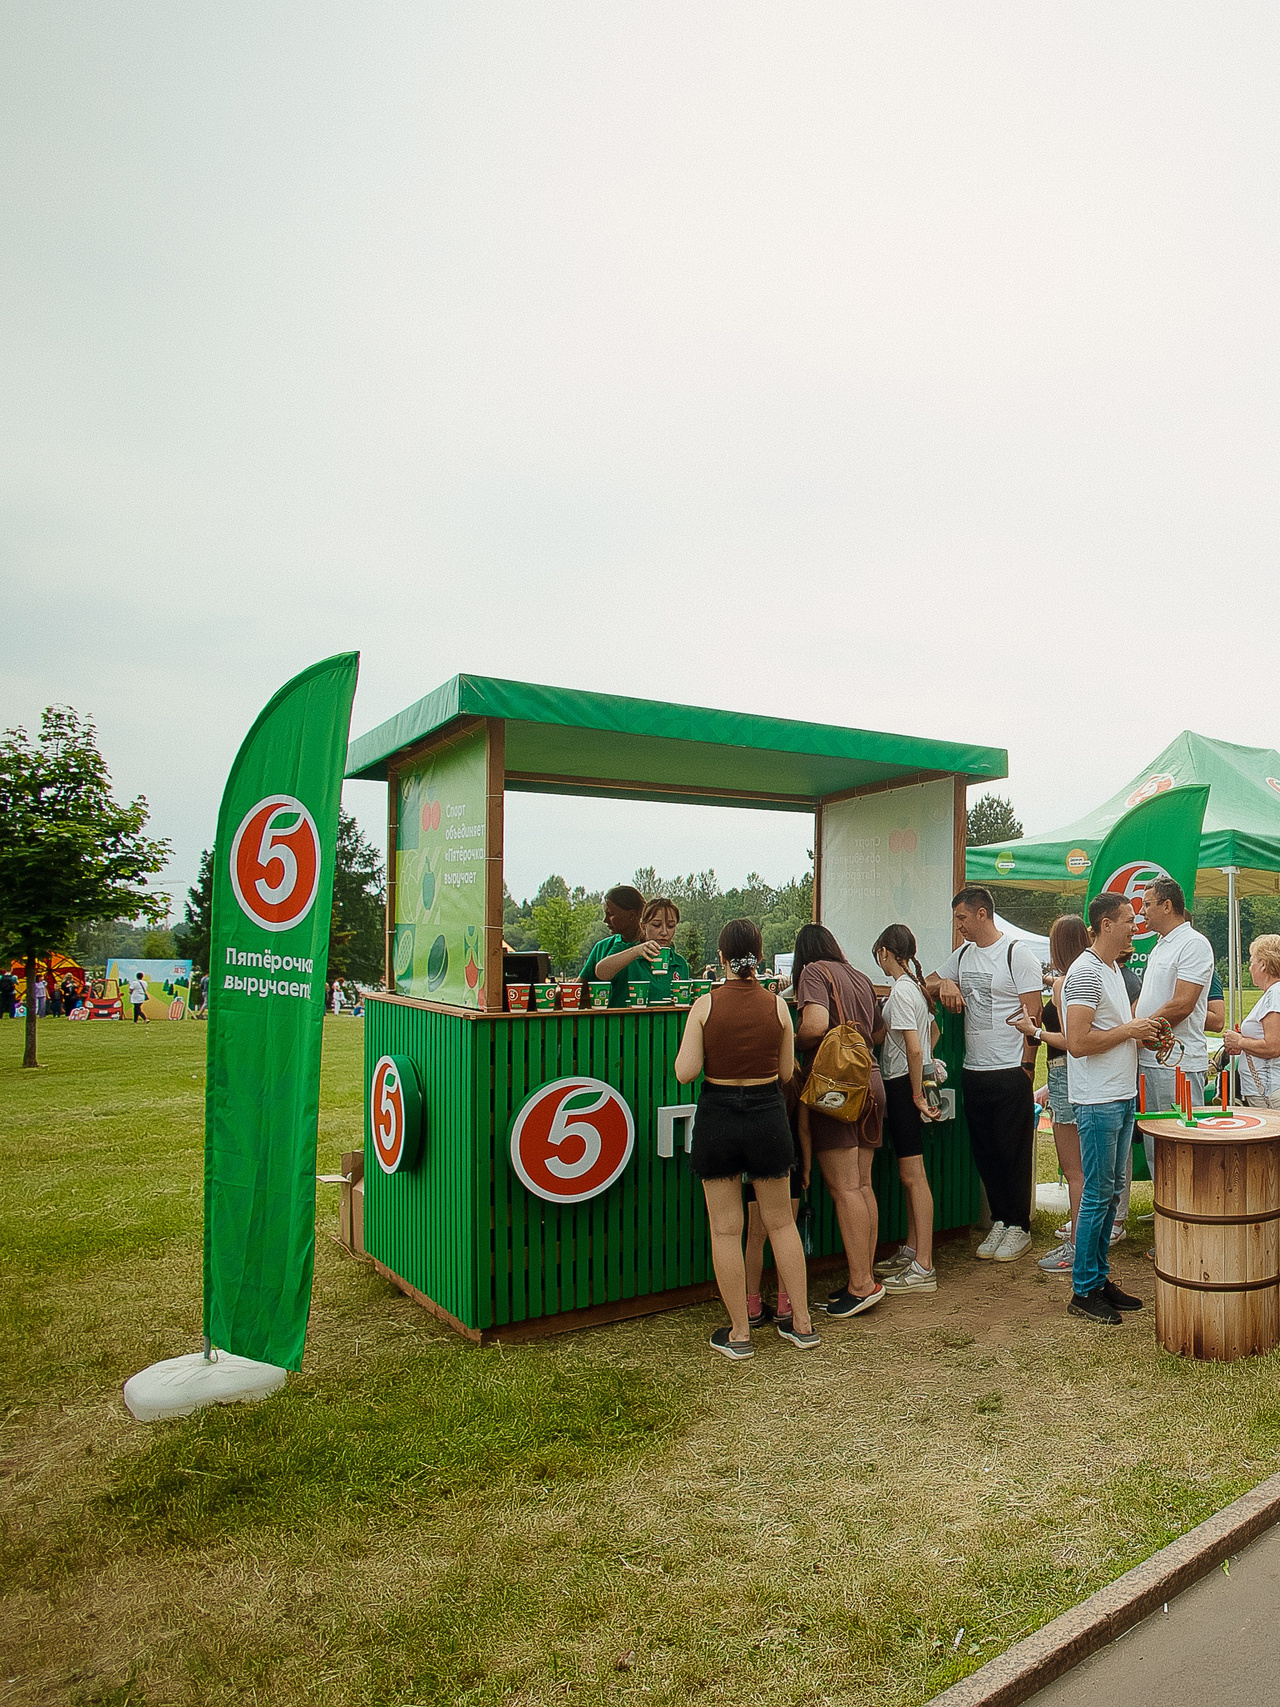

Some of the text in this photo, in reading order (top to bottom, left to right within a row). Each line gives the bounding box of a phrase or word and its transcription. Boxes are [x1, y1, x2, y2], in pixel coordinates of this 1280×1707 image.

[445, 804, 465, 820] Спорт
[445, 823, 485, 840] объединяет
[444, 871, 476, 888] выручает
